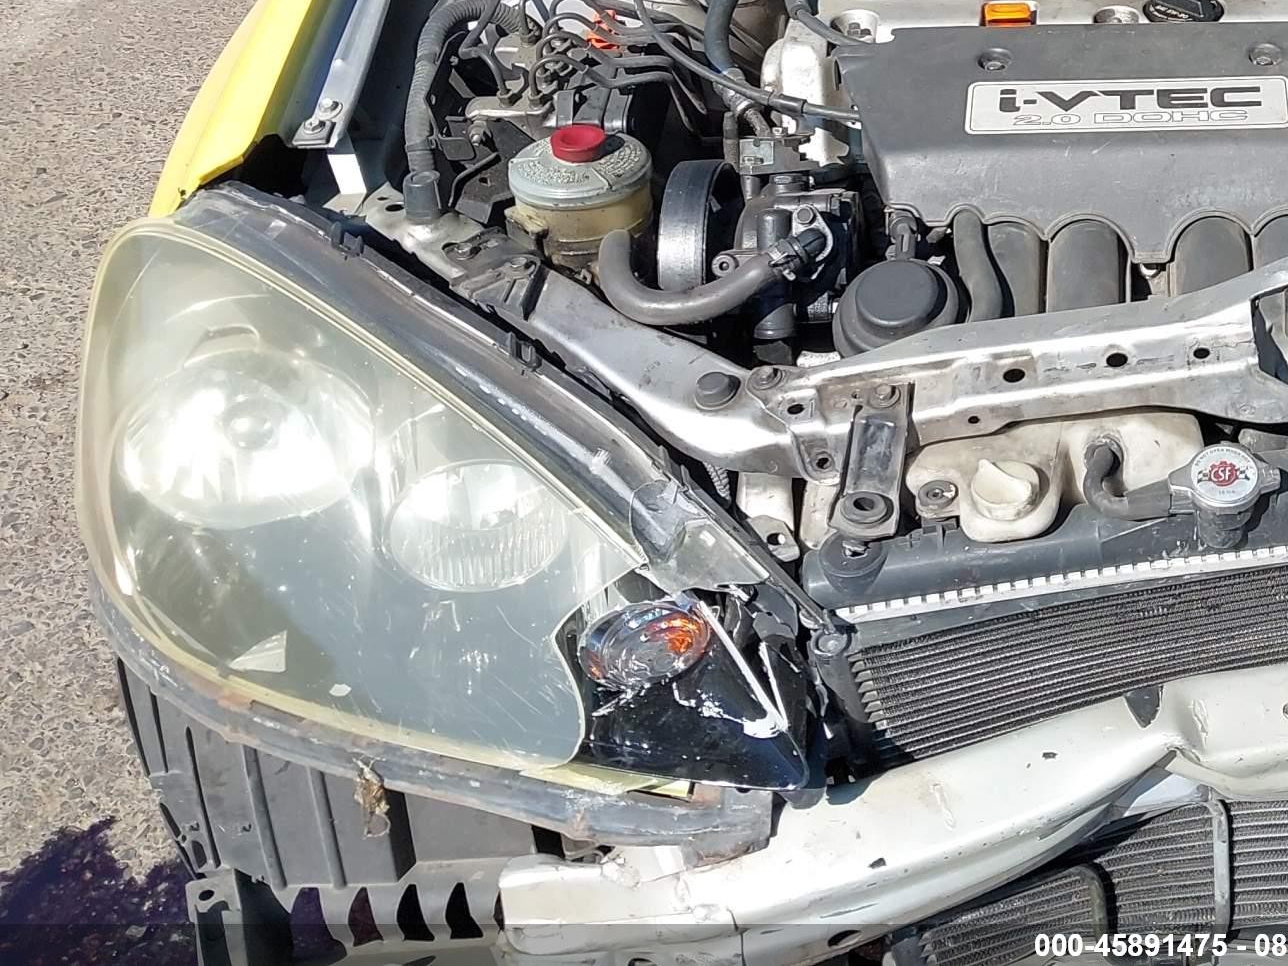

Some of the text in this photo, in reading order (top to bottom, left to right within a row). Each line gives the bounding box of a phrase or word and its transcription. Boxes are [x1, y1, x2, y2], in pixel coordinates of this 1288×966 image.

[999, 86, 1262, 112] i-VTEC
[1012, 109, 1248, 126] 2.0 DOHC
[1211, 466, 1232, 481] CSF
